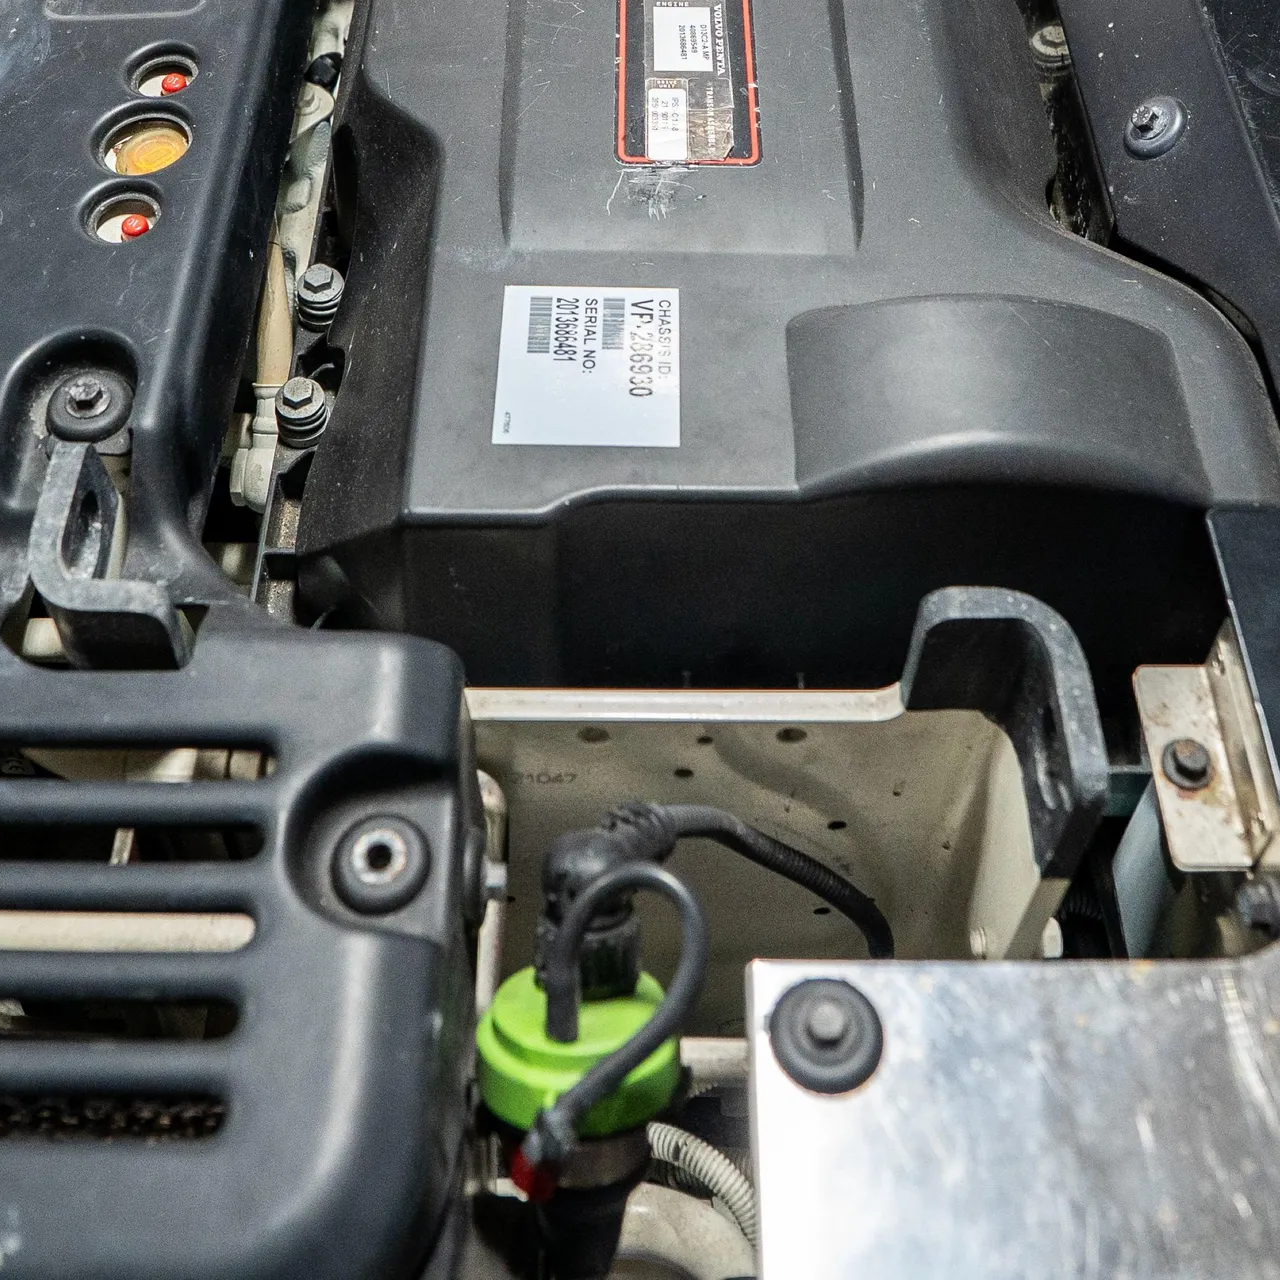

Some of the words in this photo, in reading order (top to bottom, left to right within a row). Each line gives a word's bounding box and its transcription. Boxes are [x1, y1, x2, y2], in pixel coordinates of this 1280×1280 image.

[713, 4, 724, 37] VOLVO
[715, 38, 726, 76] PENTA
[553, 298, 579, 361] 2013686481
[583, 298, 598, 345] SERIAL
[657, 300, 671, 357] CHASSIS
[582, 350, 596, 374] NO:
[657, 361, 671, 379] ID:
